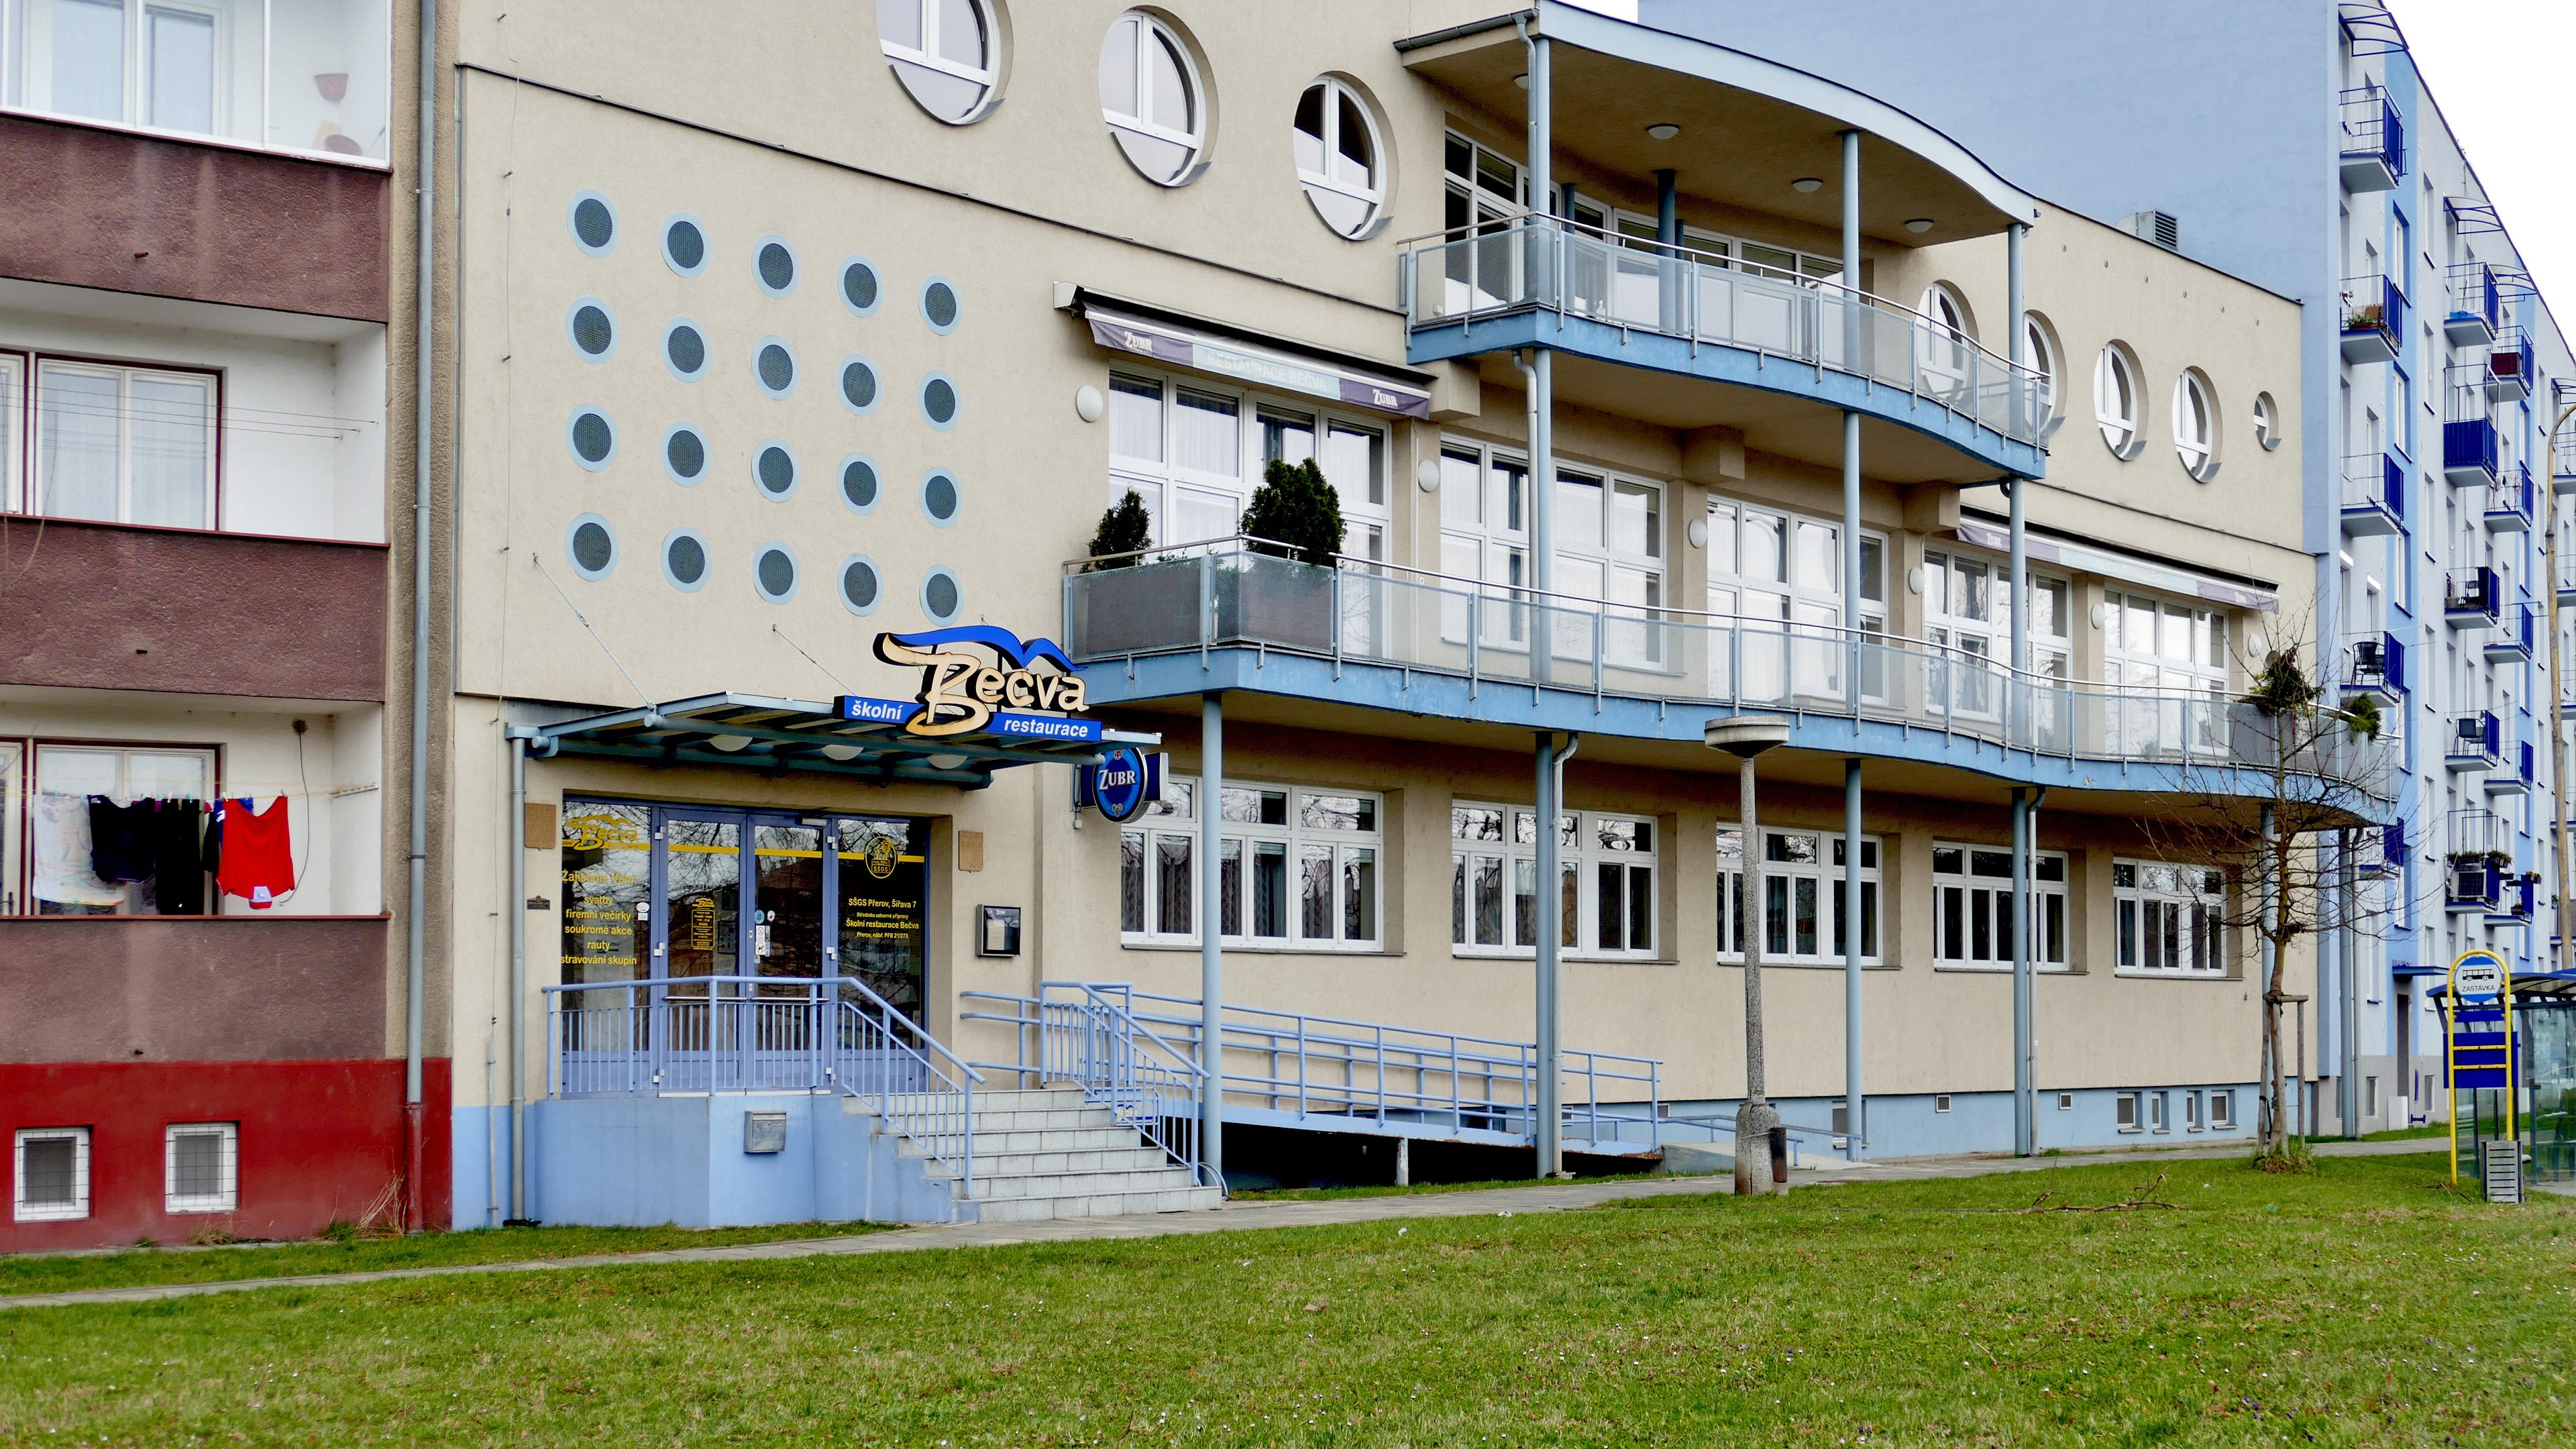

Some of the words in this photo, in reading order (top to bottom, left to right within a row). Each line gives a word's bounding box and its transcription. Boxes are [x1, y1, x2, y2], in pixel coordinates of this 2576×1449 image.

[1207, 353, 1286, 381] RESTAURACE
[1289, 370, 1328, 390] BEČVA
[851, 700, 903, 720] školní
[1004, 719, 1088, 738] restaurace
[1098, 769, 1136, 790] ZUBR
[584, 896, 613, 906] svatby
[848, 896, 867, 906] SŠGS
[868, 899, 890, 908] Přerov,
[892, 898, 912, 908] Šířava
[566, 909, 597, 919] firemní
[600, 911, 631, 922] večírky
[846, 918, 865, 927] Školní
[866, 920, 899, 928] restaurace
[900, 921, 919, 929] Bečva
[565, 924, 608, 934] soukromé
[611, 926, 633, 935] akce
[587, 941, 610, 951] rauty
[561, 955, 605, 965] stravování
[608, 956, 637, 966] skupin
[2462, 984, 2495, 992] ZASTÁVKA
